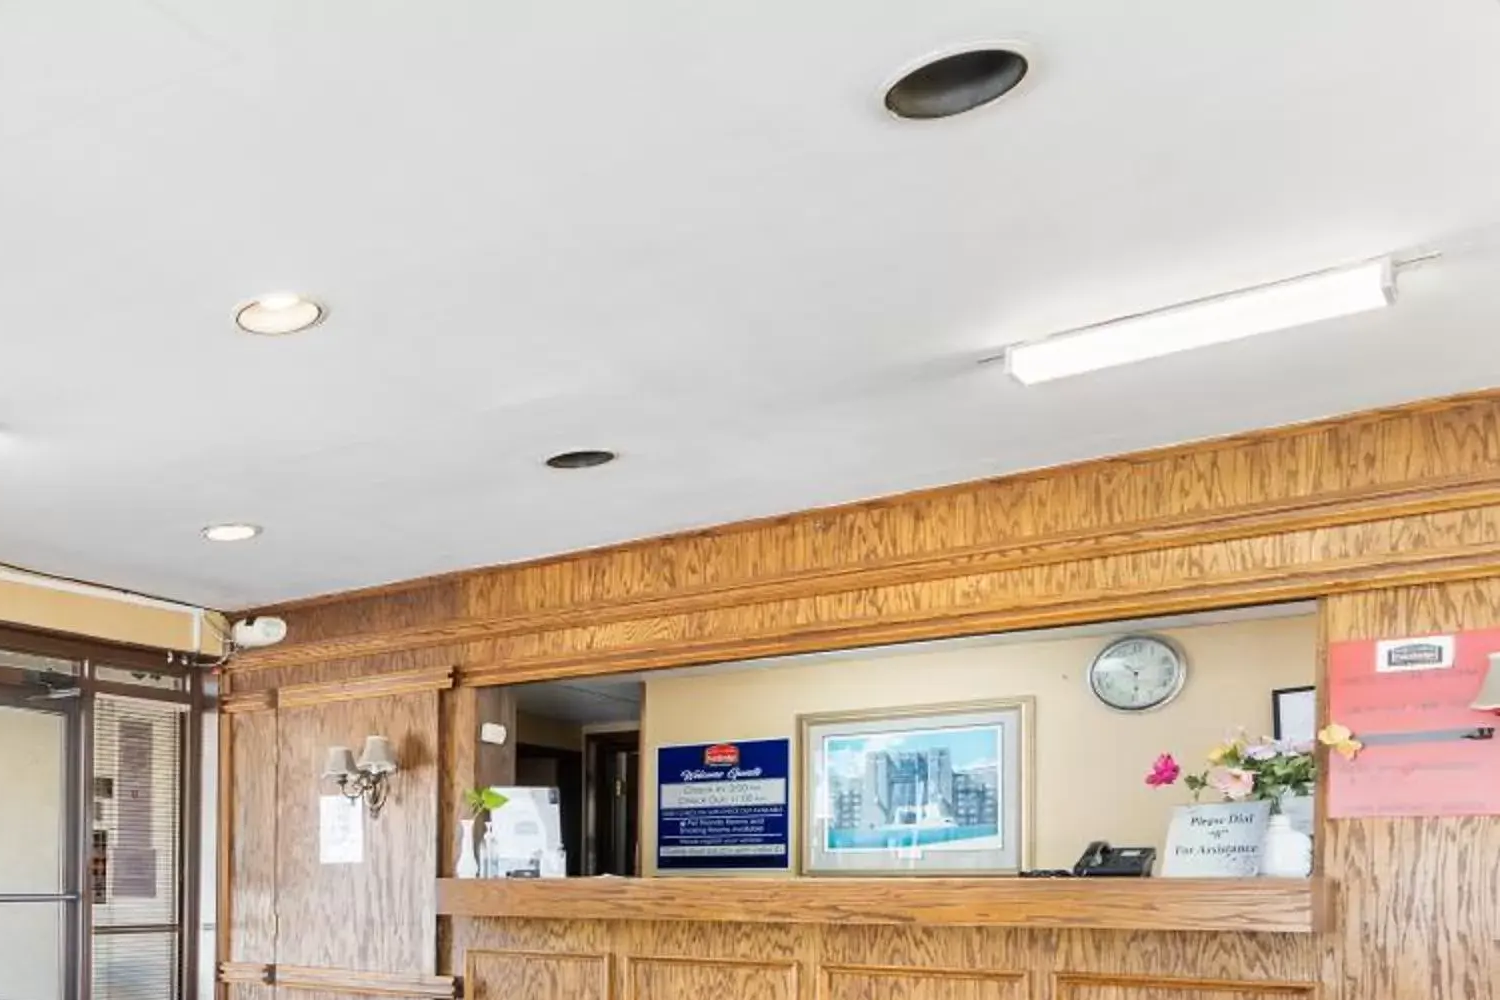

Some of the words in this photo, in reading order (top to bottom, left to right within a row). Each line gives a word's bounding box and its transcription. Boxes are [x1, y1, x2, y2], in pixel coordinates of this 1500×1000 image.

[1191, 815, 1225, 826] Please
[1229, 813, 1254, 824] Dial
[1175, 846, 1194, 856] For
[1196, 842, 1259, 857] Assistance
